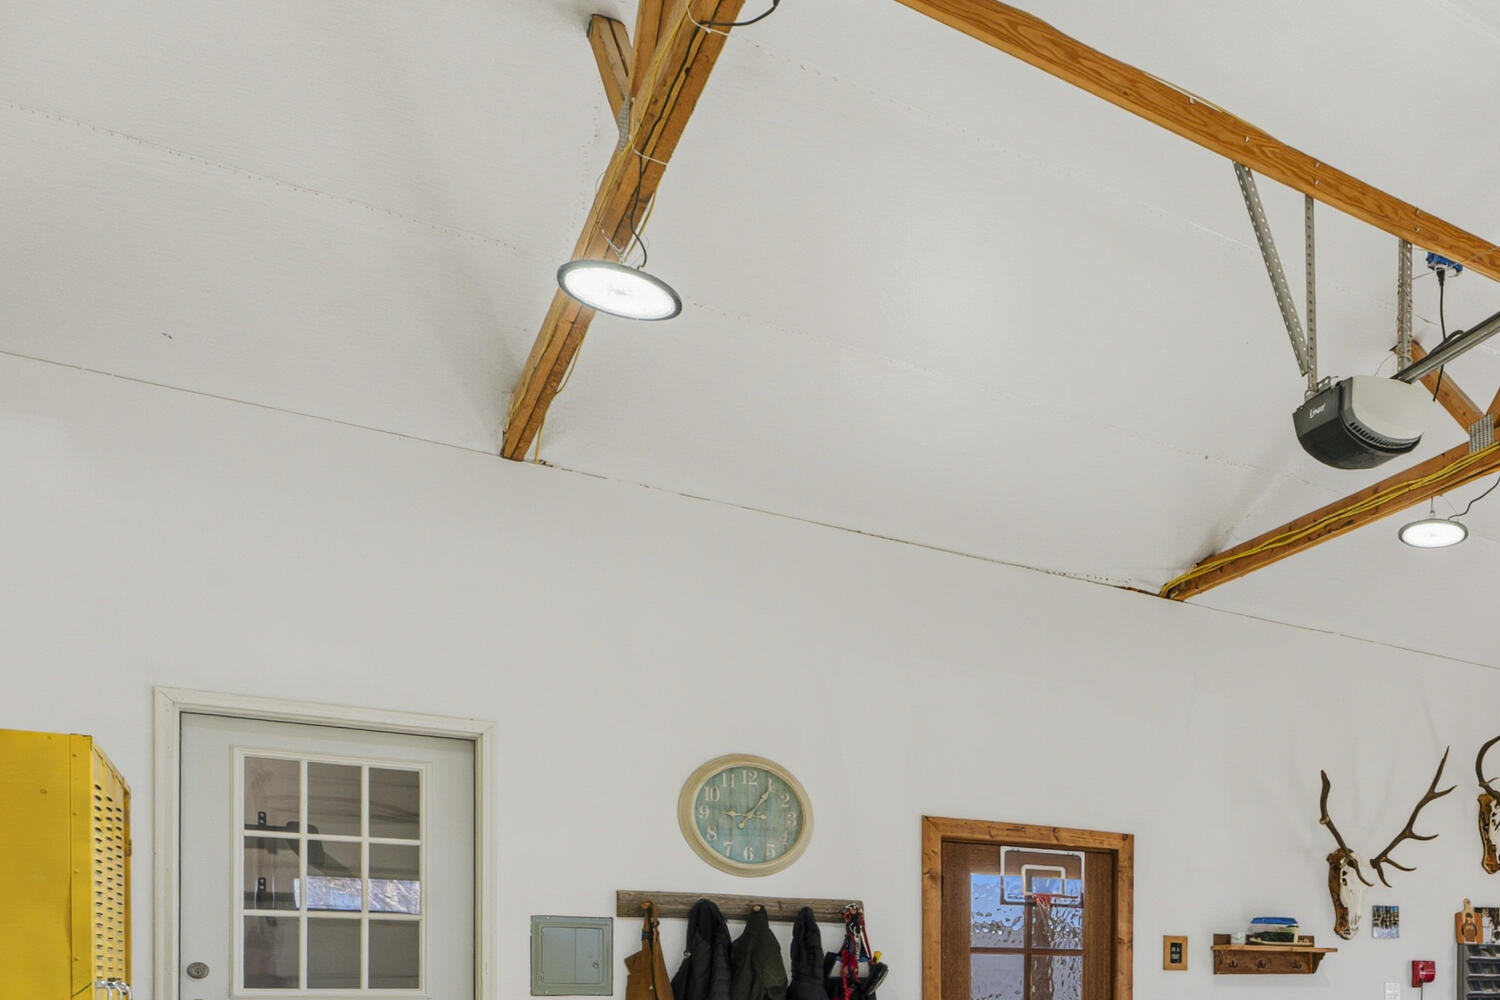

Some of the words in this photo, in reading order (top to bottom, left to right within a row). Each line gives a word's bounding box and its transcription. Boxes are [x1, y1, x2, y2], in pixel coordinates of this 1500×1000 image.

[721, 772, 735, 788] 11
[741, 769, 758, 785] 12
[703, 786, 720, 802] 10
[780, 794, 790, 808] 2
[698, 804, 710, 819] 9
[787, 811, 798, 827] 3
[706, 825, 718, 841] 8
[779, 830, 789, 846] 4
[723, 841, 734, 857] 7
[743, 846, 754, 861] 6
[766, 843, 776, 859] 5
